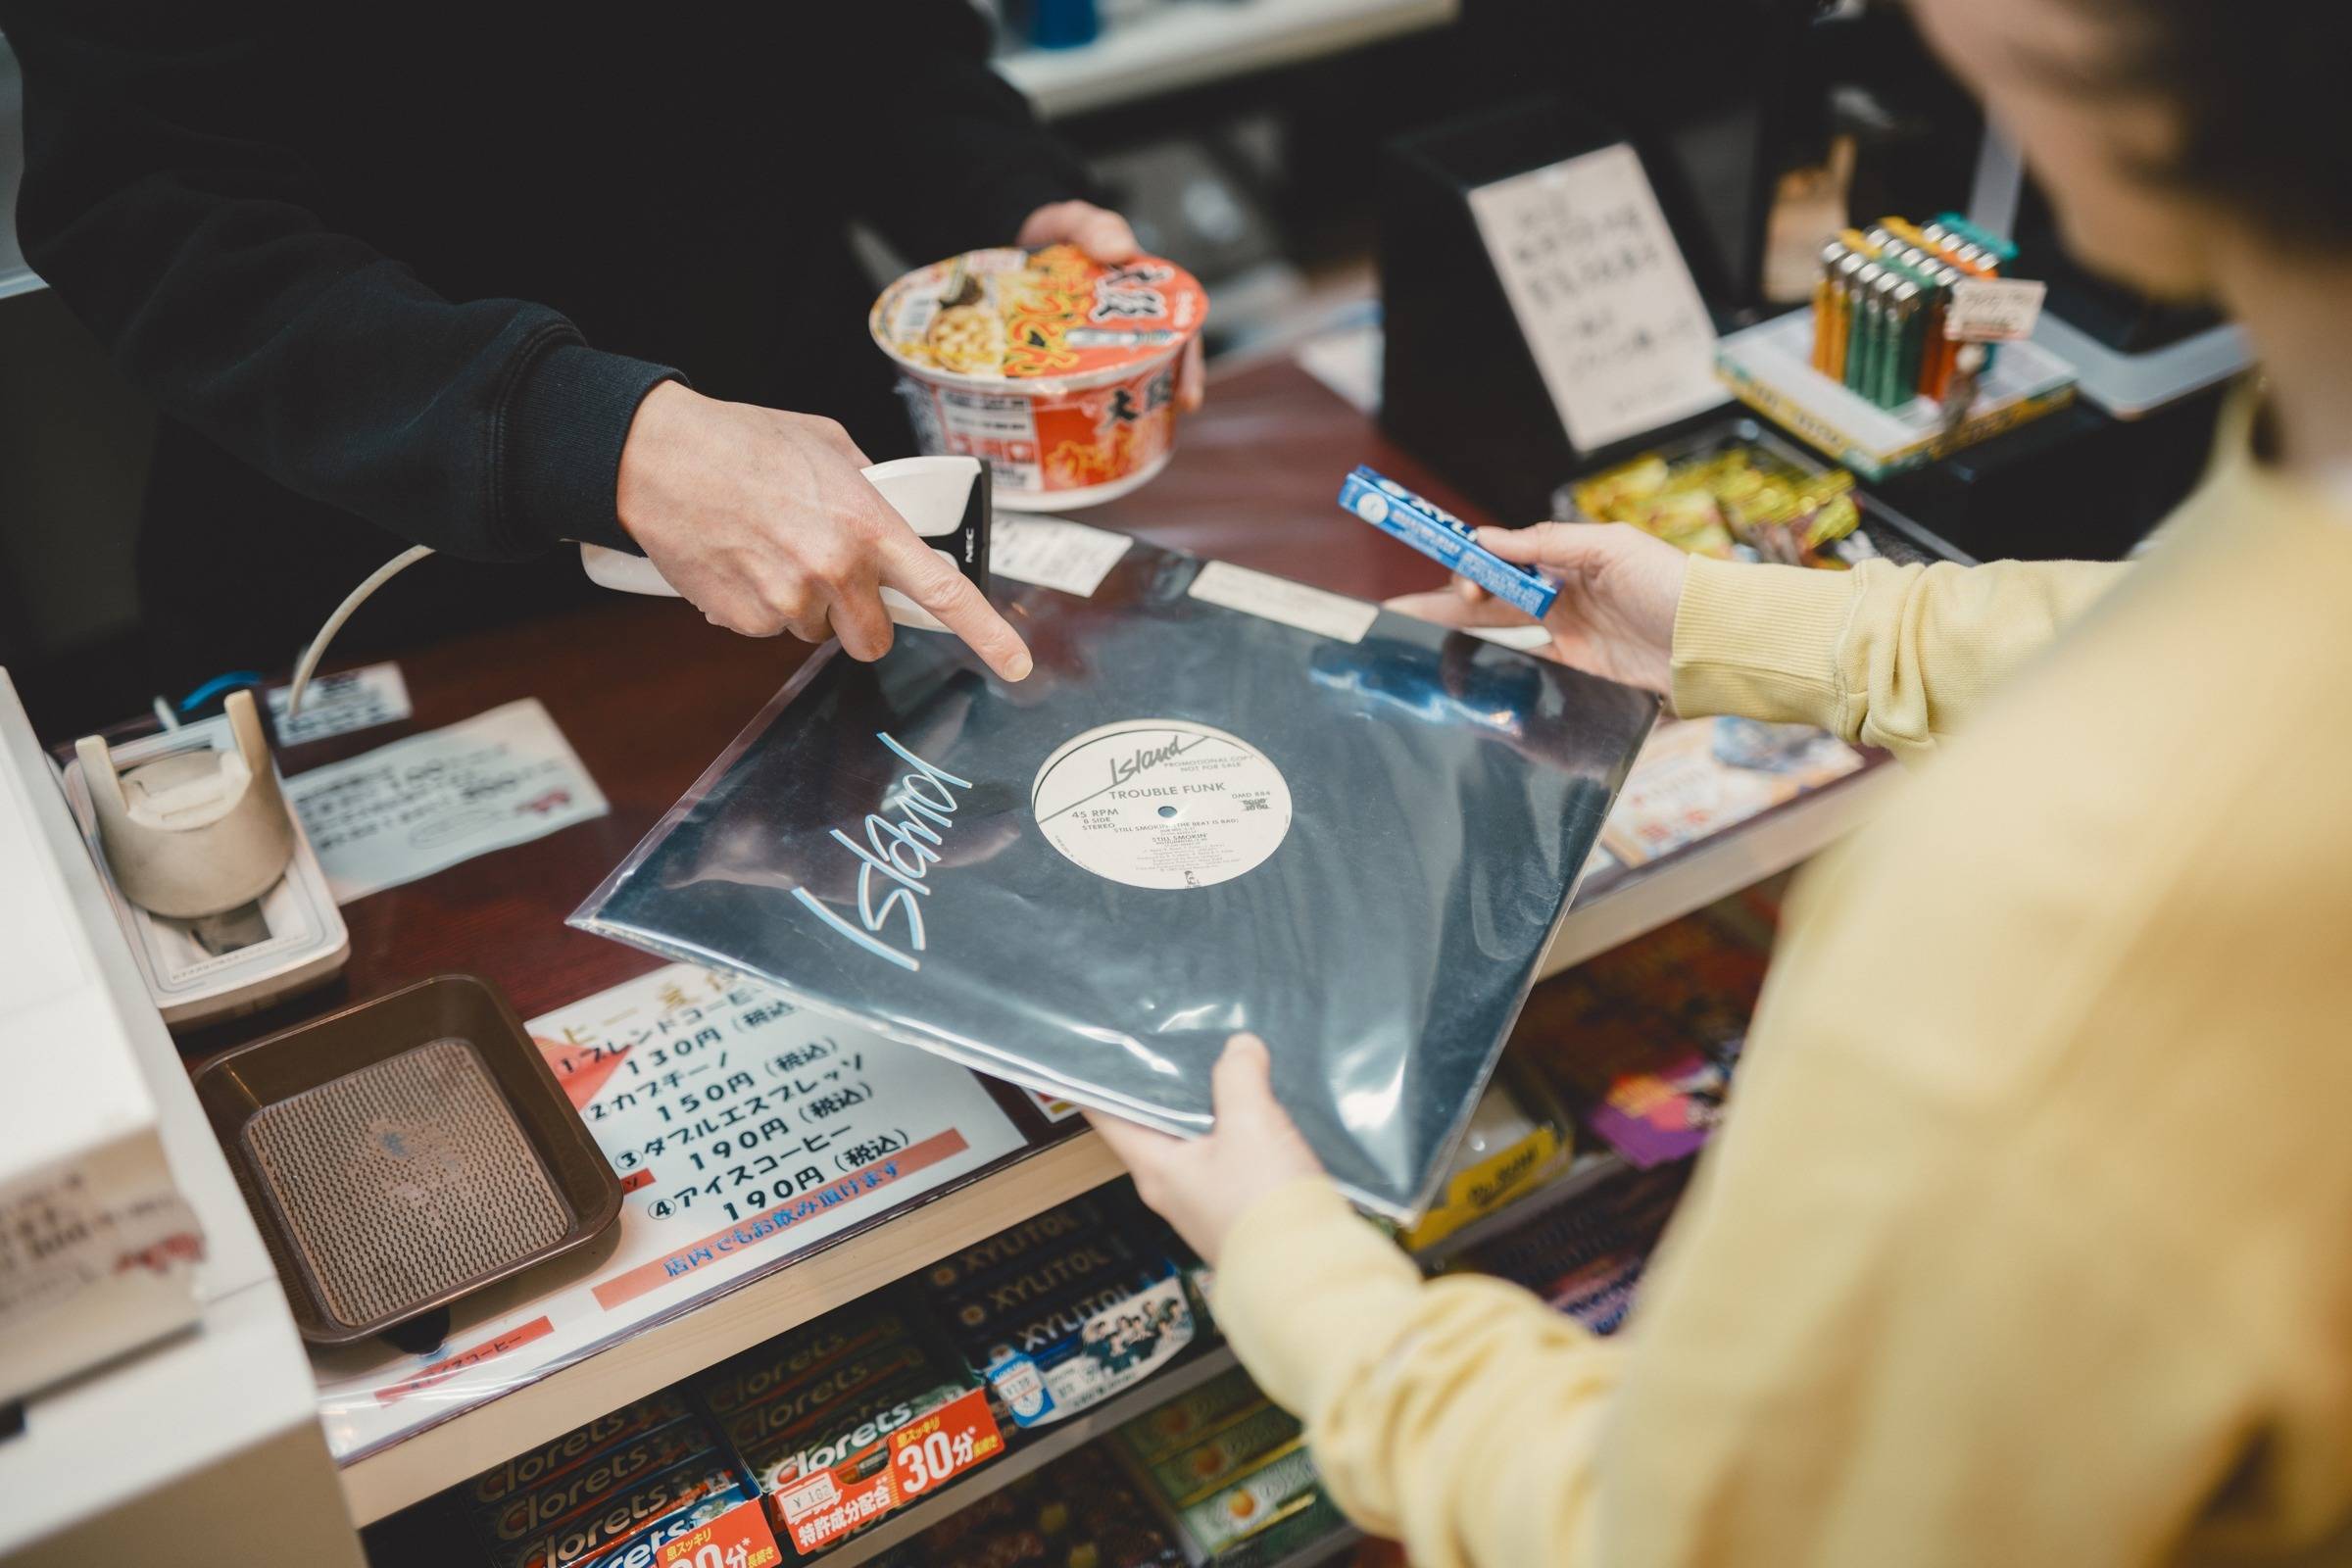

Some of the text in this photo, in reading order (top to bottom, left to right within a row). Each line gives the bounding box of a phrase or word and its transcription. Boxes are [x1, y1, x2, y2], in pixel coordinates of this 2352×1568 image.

[965, 527, 974, 563] NEC
[1108, 782, 1226, 801] TROUBLE FUNK
[1110, 736, 1182, 785] Island
[1163, 754, 1254, 768] PROMOTIONAL COPY
[1072, 808, 1119, 819] 45 RPM
[1081, 822, 1115, 831] STEREO
[1152, 835, 1173, 844] STILL
[1174, 832, 1207, 841] SMOKIN'
[791, 732, 972, 971] Island
[959, 1210, 1082, 1272] XYLITOL
[989, 1245, 1113, 1312] XYLITOL
[1018, 1284, 1132, 1352] XYLITOL
[711, 1332, 849, 1412] Clorets
[732, 1361, 870, 1446] Clorets
[475, 1411, 624, 1503] Clorets
[768, 1401, 912, 1491] Clorets
[495, 1444, 649, 1541] Clorets
[516, 1484, 668, 1568] Clorets
[608, 1518, 686, 1568] rets
[666, 1527, 712, 1561] 息スッキリ
